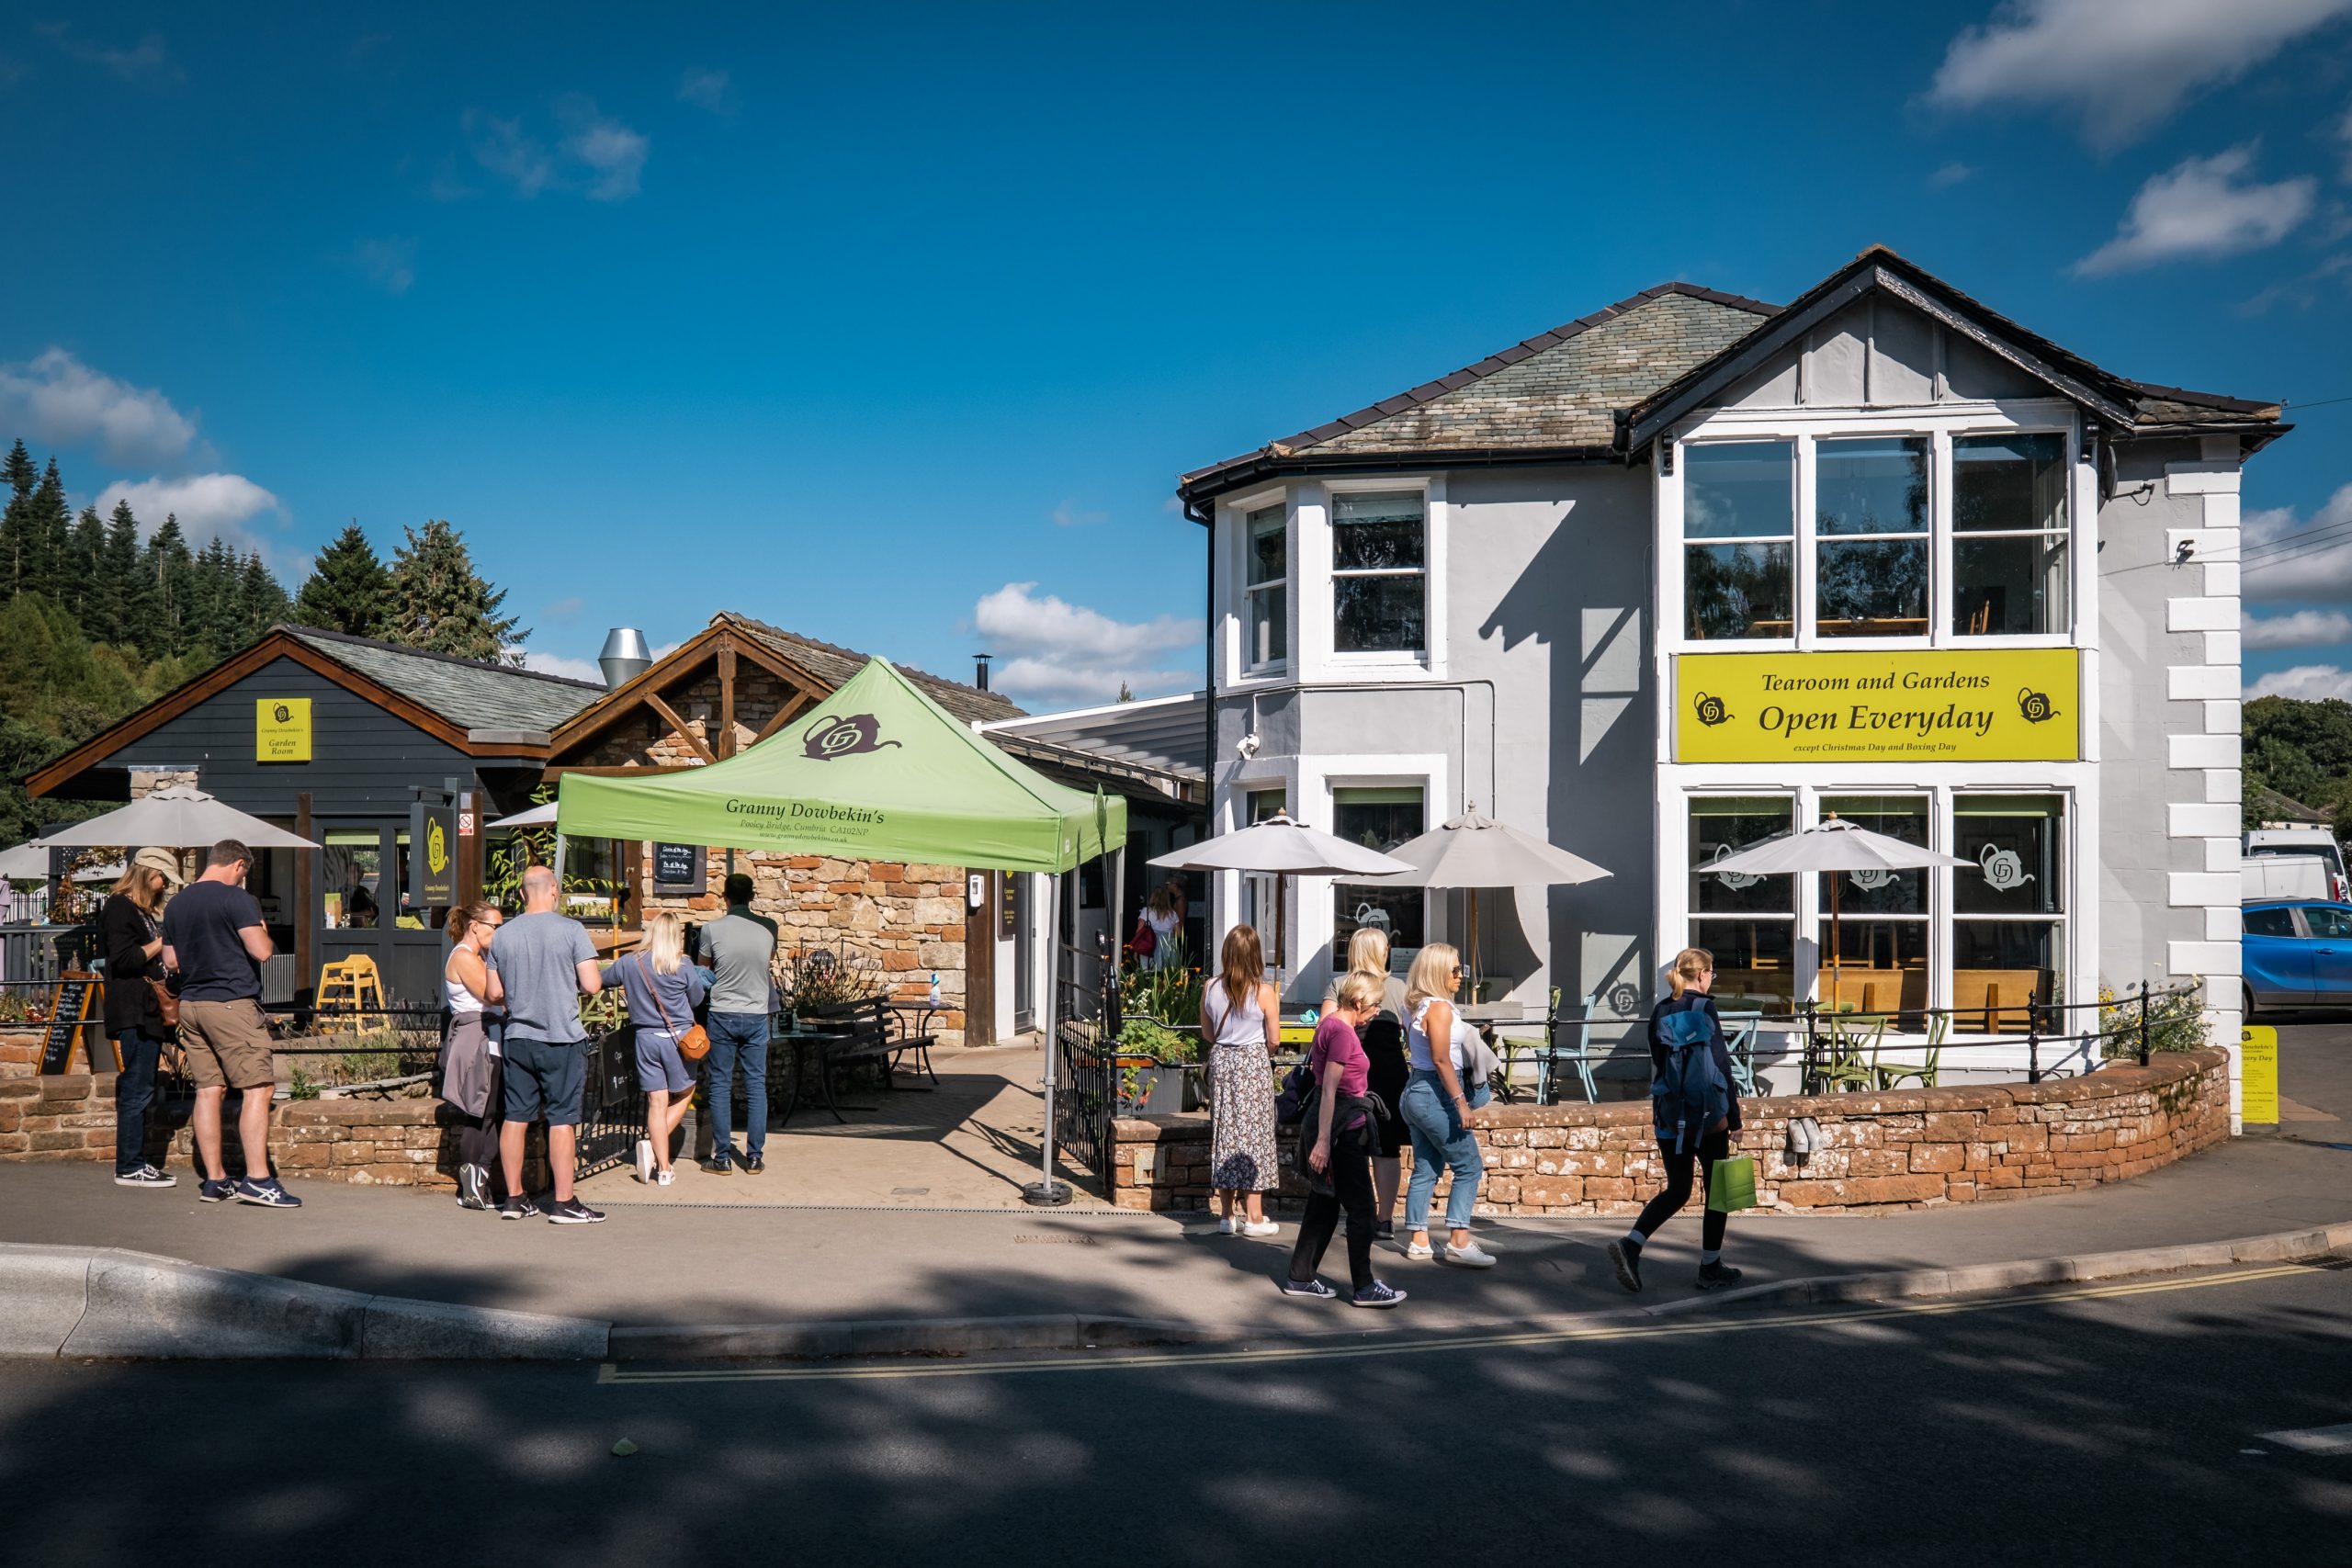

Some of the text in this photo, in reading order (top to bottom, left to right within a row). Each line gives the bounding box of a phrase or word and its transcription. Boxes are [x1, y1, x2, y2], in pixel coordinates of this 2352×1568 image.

[1761, 671, 1990, 691] Tearoom and Gardens
[1758, 703, 1994, 739] Open Everyday
[268, 739, 296, 747] Garden
[1793, 742, 1957, 753] except Christmas Day and Boxing Day
[271, 747, 294, 755] Room
[726, 798, 885, 824] Granny Dowbekin's
[741, 819, 869, 836] Pooley Bridge, Cumbria CA102NP
[759, 832, 847, 843] www.grannydowbekins.co.uk
[2258, 1055, 2273, 1063] Day
